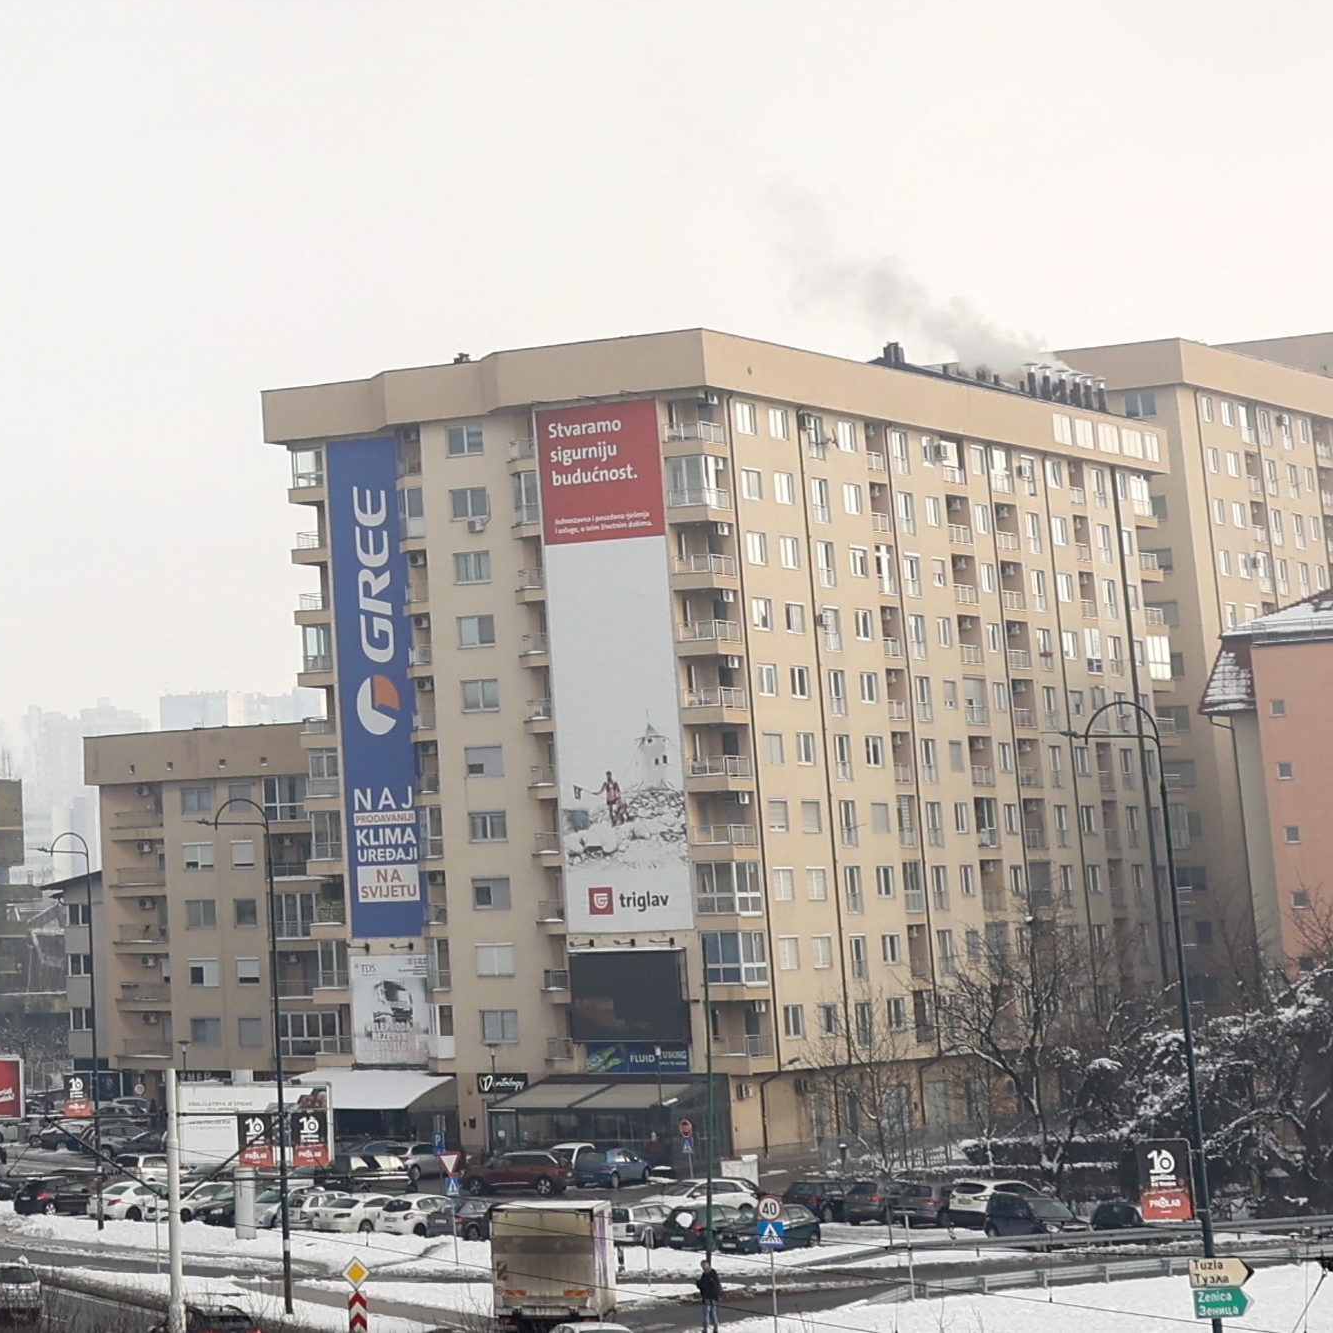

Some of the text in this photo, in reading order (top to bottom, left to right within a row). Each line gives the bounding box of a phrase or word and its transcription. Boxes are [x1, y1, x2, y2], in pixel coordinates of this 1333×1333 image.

[548, 419, 622, 439] Stvaramo
[550, 441, 617, 466] sigurniju
[552, 464, 638, 486] budućnost.
[352, 483, 395, 663] GREE
[354, 786, 413, 811] NAJ
[356, 827, 417, 846] KLIMA
[357, 847, 418, 862] UREĐAJI
[376, 869, 402, 883] NA
[361, 884, 417, 899] SVIJETU
[619, 889, 670, 913] triglav
[629, 1054, 655, 1063] FLUID
[245, 1117, 264, 1136] 10
[298, 1115, 319, 1133] 10
[1147, 1149, 1175, 1173] 10
[762, 1202, 777, 1215] 40
[1149, 1197, 1181, 1208] PROLAB
[1193, 1259, 1224, 1271] Tuzla
[1194, 1273, 1230, 1287] Тузла
[1198, 1292, 1232, 1303] Zenica
[1198, 1305, 1240, 1317] Зеница
